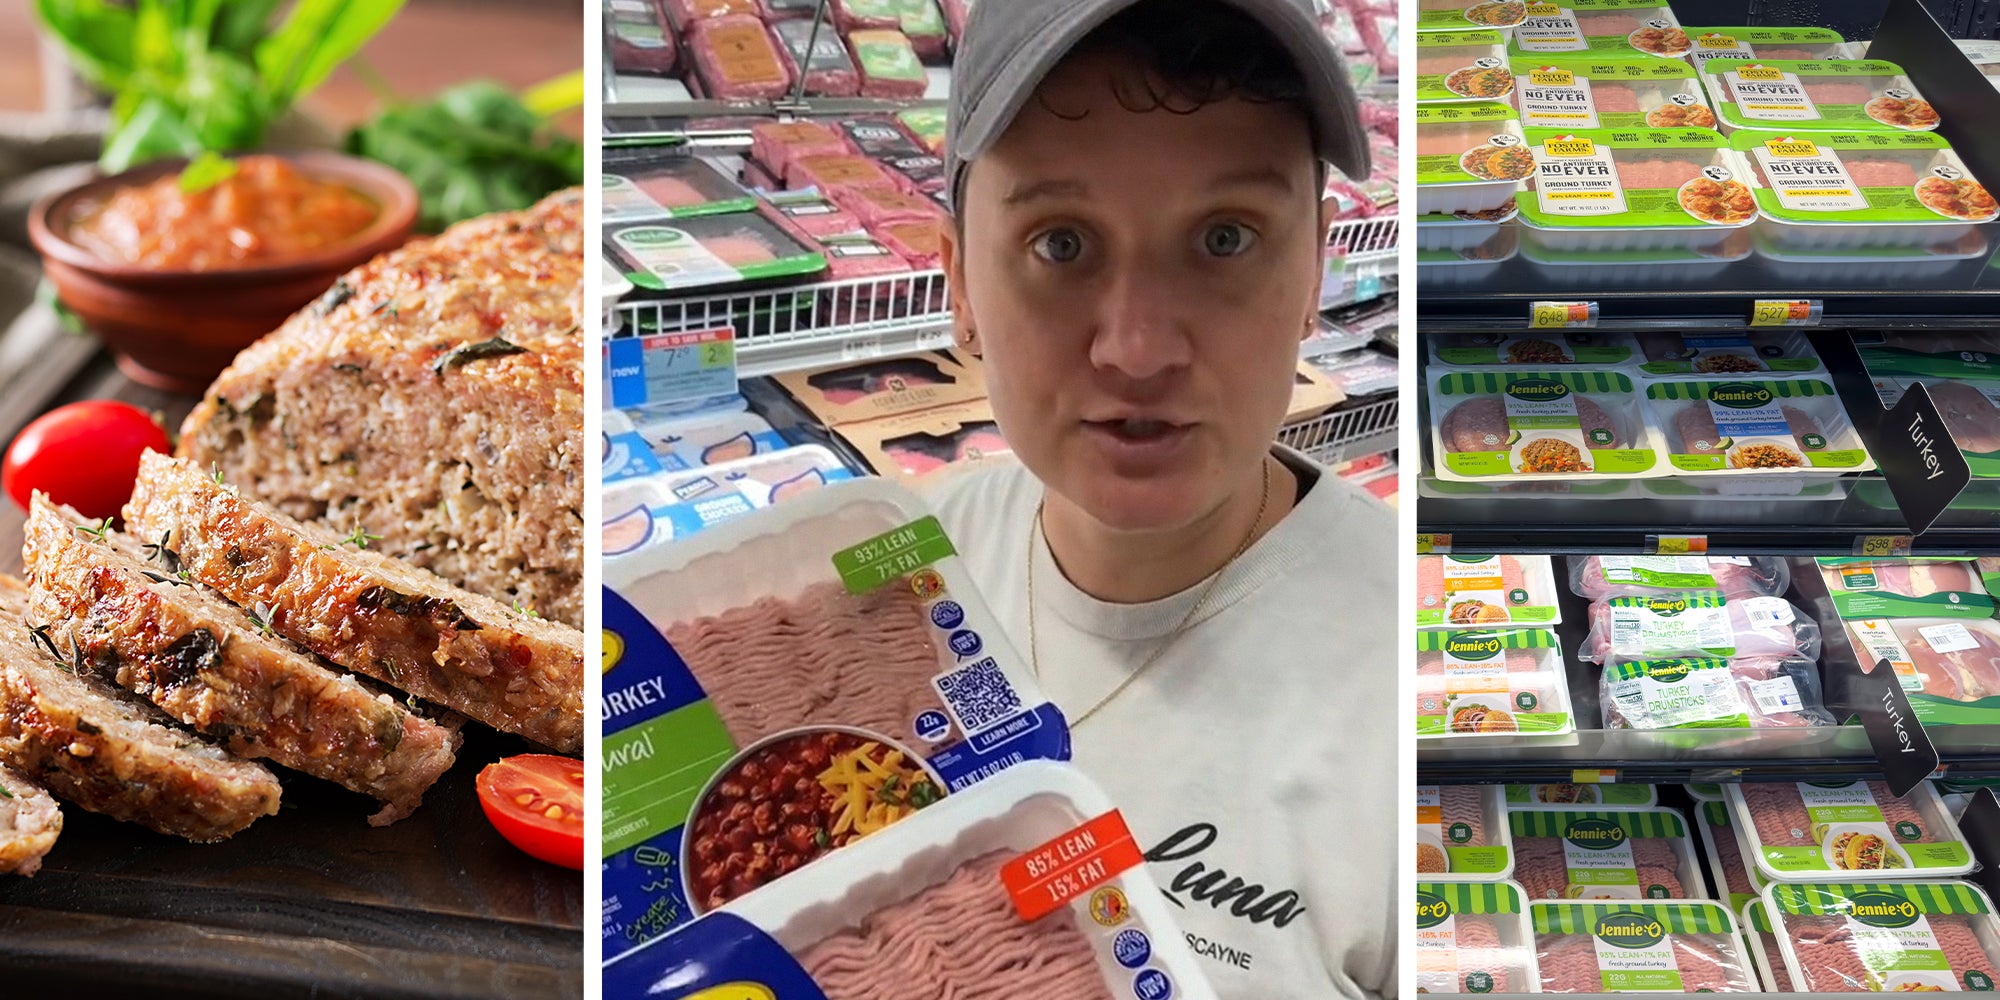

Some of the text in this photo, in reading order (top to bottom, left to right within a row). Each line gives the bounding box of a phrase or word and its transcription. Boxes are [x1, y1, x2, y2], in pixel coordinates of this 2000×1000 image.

[1541, 165, 1610, 175] NO EVER
[1793, 166, 1840, 174] EVER
[612, 366, 640, 378] new
[1908, 412, 1944, 480] Turkey
[854, 528, 917, 563] 93% LEAN
[1866, 539, 1890, 552] 598
[876, 549, 922, 580] 7% FAT
[1642, 630, 1698, 638] DRUMSTICKS
[1652, 621, 1685, 630] TURKEY
[1448, 640, 1499, 652] Jennie-O
[602, 676, 666, 720] URKEY
[1656, 686, 1691, 698] TURKEY
[1648, 695, 1705, 712] DRUMSTICKS
[921, 714, 940, 728] 22g
[1880, 687, 1916, 753] Turkey
[980, 716, 1030, 746] LEARN MORE
[950, 778, 968, 793] NET
[966, 771, 982, 786] WT
[980, 768, 989, 780] 16
[989, 762, 1001, 776] OZ
[1568, 827, 1623, 841] Jennie-O
[1026, 830, 1096, 878] 85% LEAN
[1046, 858, 1106, 902] 15% FAT
[626, 896, 670, 940] Create
[1851, 901, 1915, 918] Jennie-O
[1598, 922, 1662, 938] Jennie-O
[1182, 930, 1253, 970] SCAYNE
[1908, 940, 1928, 948] turkey
